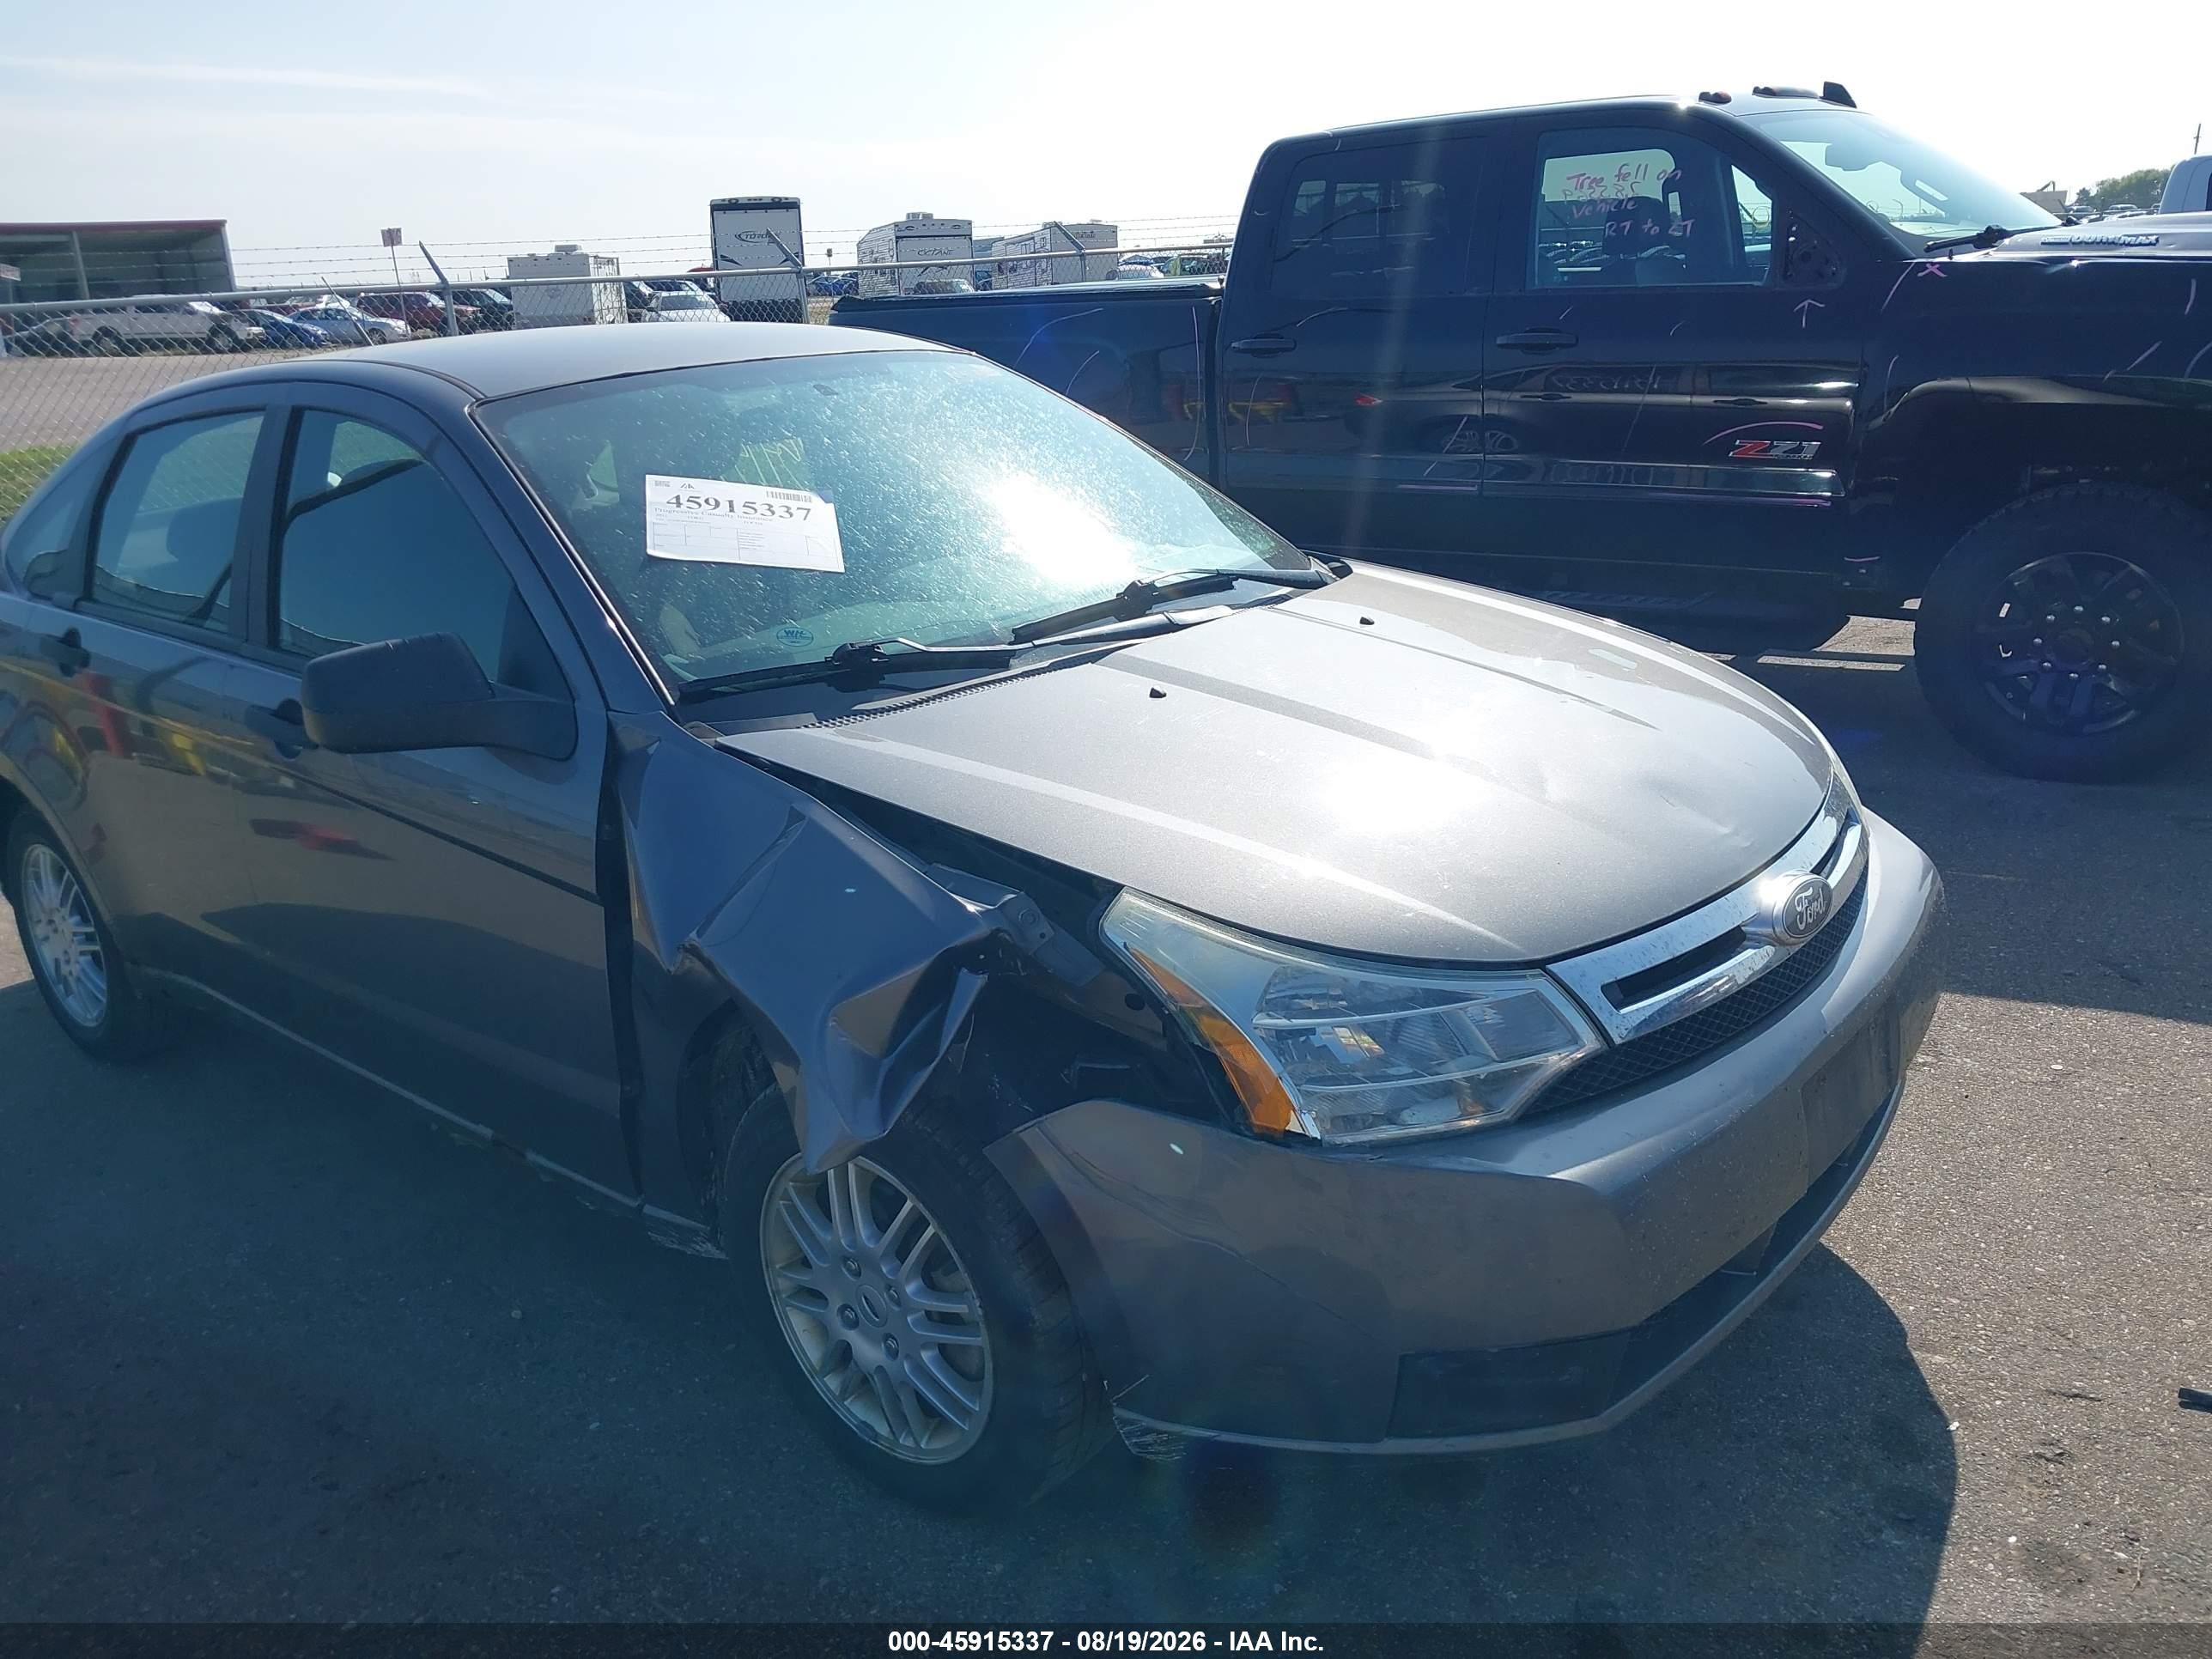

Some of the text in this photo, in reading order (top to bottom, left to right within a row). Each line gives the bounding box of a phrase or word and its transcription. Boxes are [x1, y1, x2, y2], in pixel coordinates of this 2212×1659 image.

[1566, 163, 1683, 191] Tree fell on
[1604, 220, 1632, 238] RT
[1642, 218, 1660, 235] to
[917, 247, 955, 257] OCTANE
[1729, 439, 1821, 458] Z71
[666, 494, 811, 521] 45915337
[1795, 887, 1826, 930] Ford
